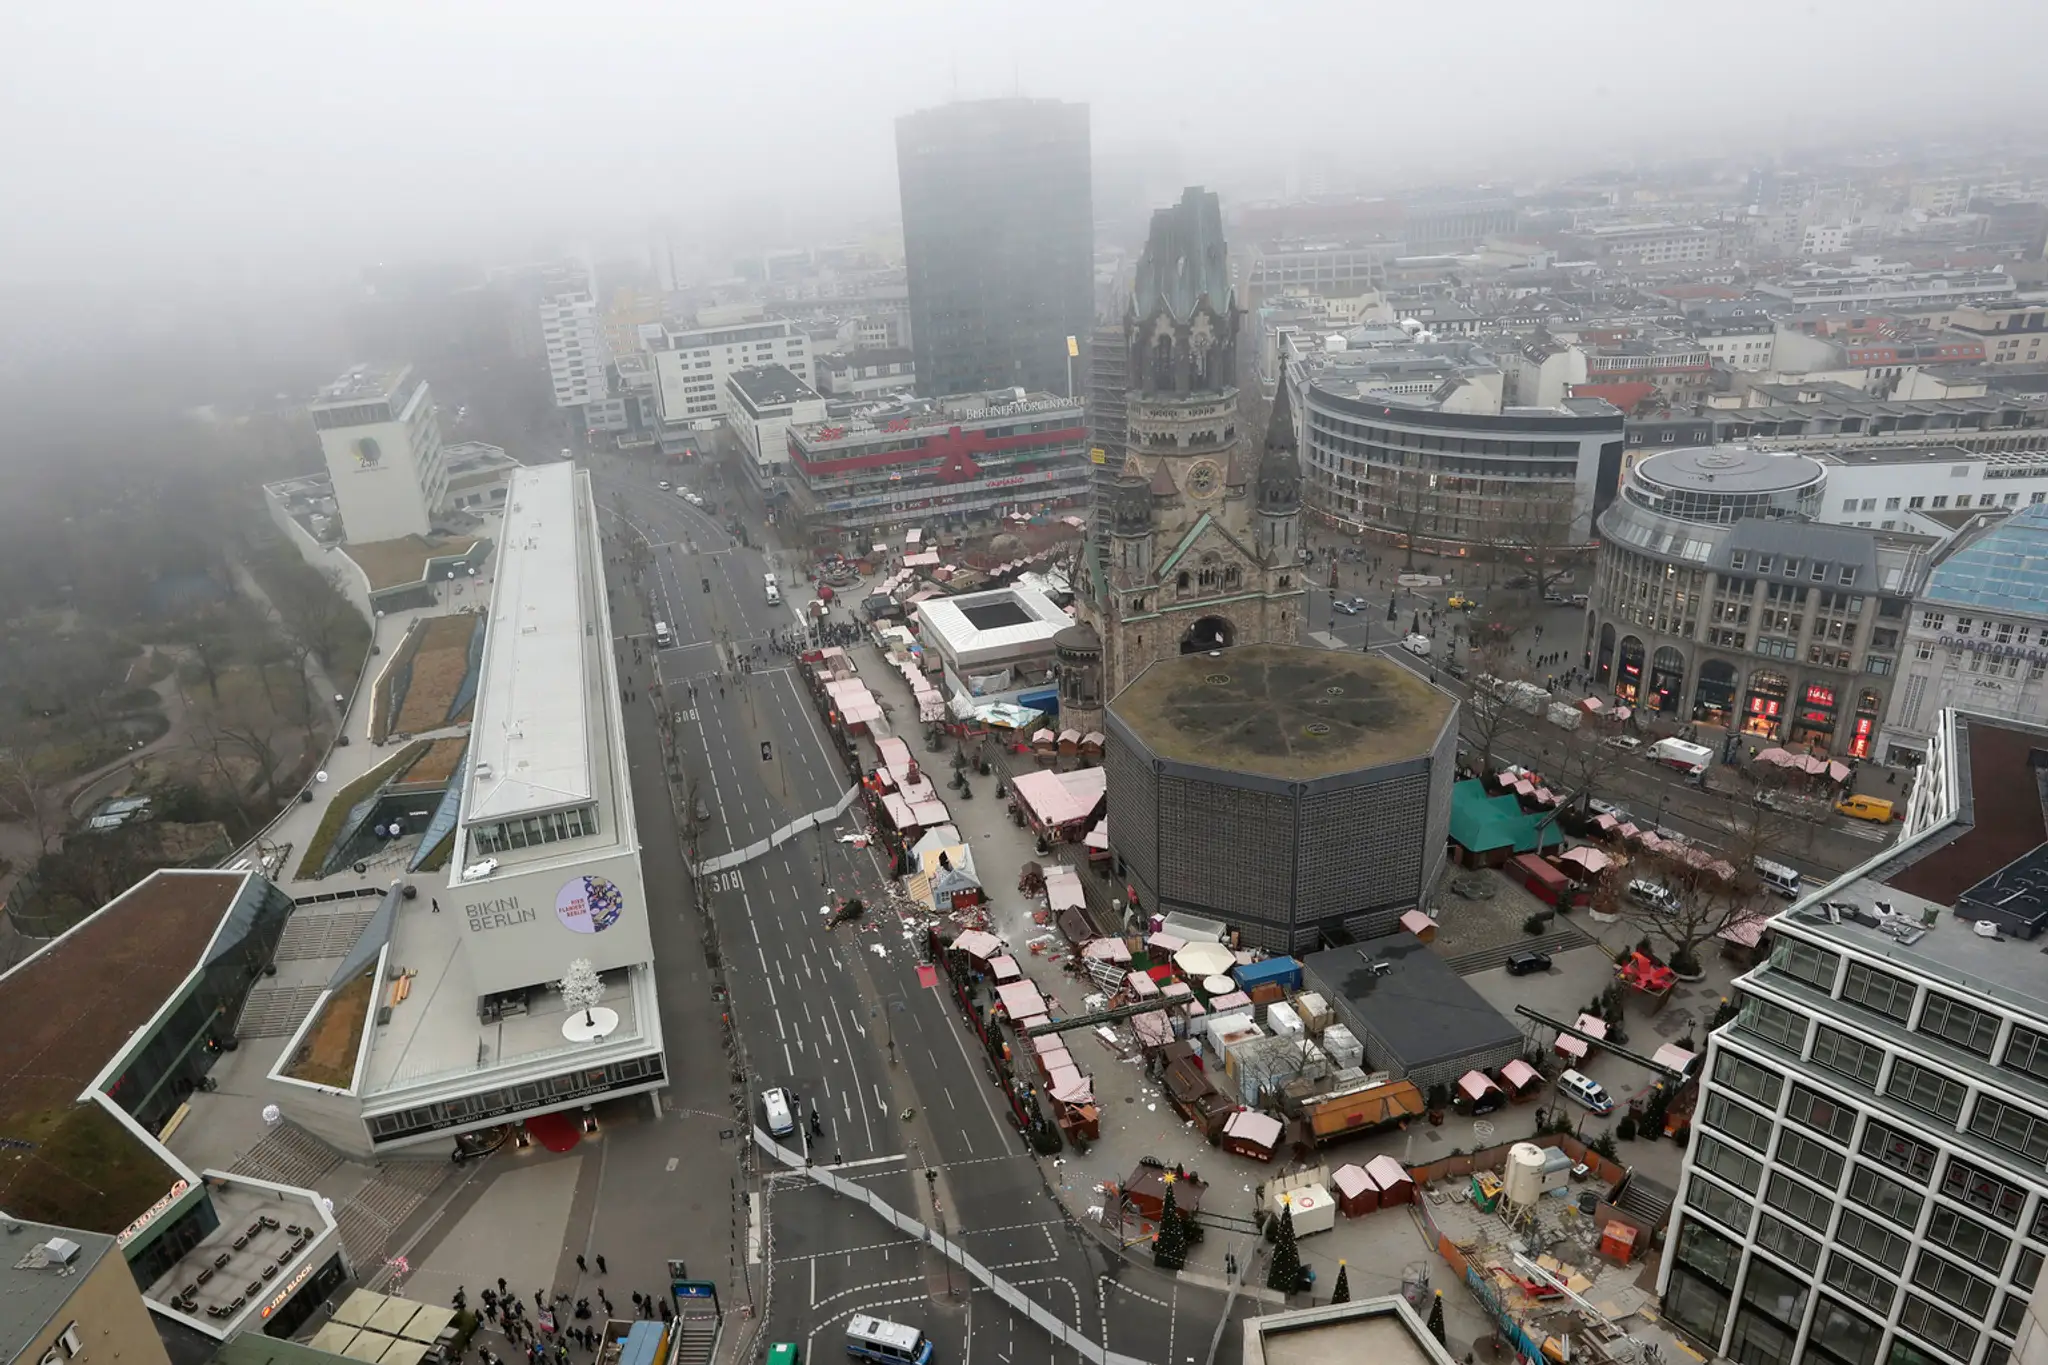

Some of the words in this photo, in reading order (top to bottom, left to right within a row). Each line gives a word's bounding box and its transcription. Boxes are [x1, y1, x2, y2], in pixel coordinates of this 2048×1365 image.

[985, 476, 1025, 488] VAPIANO
[1973, 678, 2002, 691] ZARA
[713, 872, 740, 892] BUS
[465, 896, 519, 918] BIKINI
[469, 908, 536, 932] BERLIN
[457, 1114, 483, 1124] BEAUTY
[489, 1108, 506, 1118] LOOK
[512, 1101, 540, 1112] BEYOND
[545, 1096, 561, 1104] LOVE
[567, 1085, 611, 1100] WUNDERBAR
[135, 1196, 172, 1228] HOUSE
[271, 1290, 288, 1309] JIM
[286, 1263, 313, 1293] BLOCK
